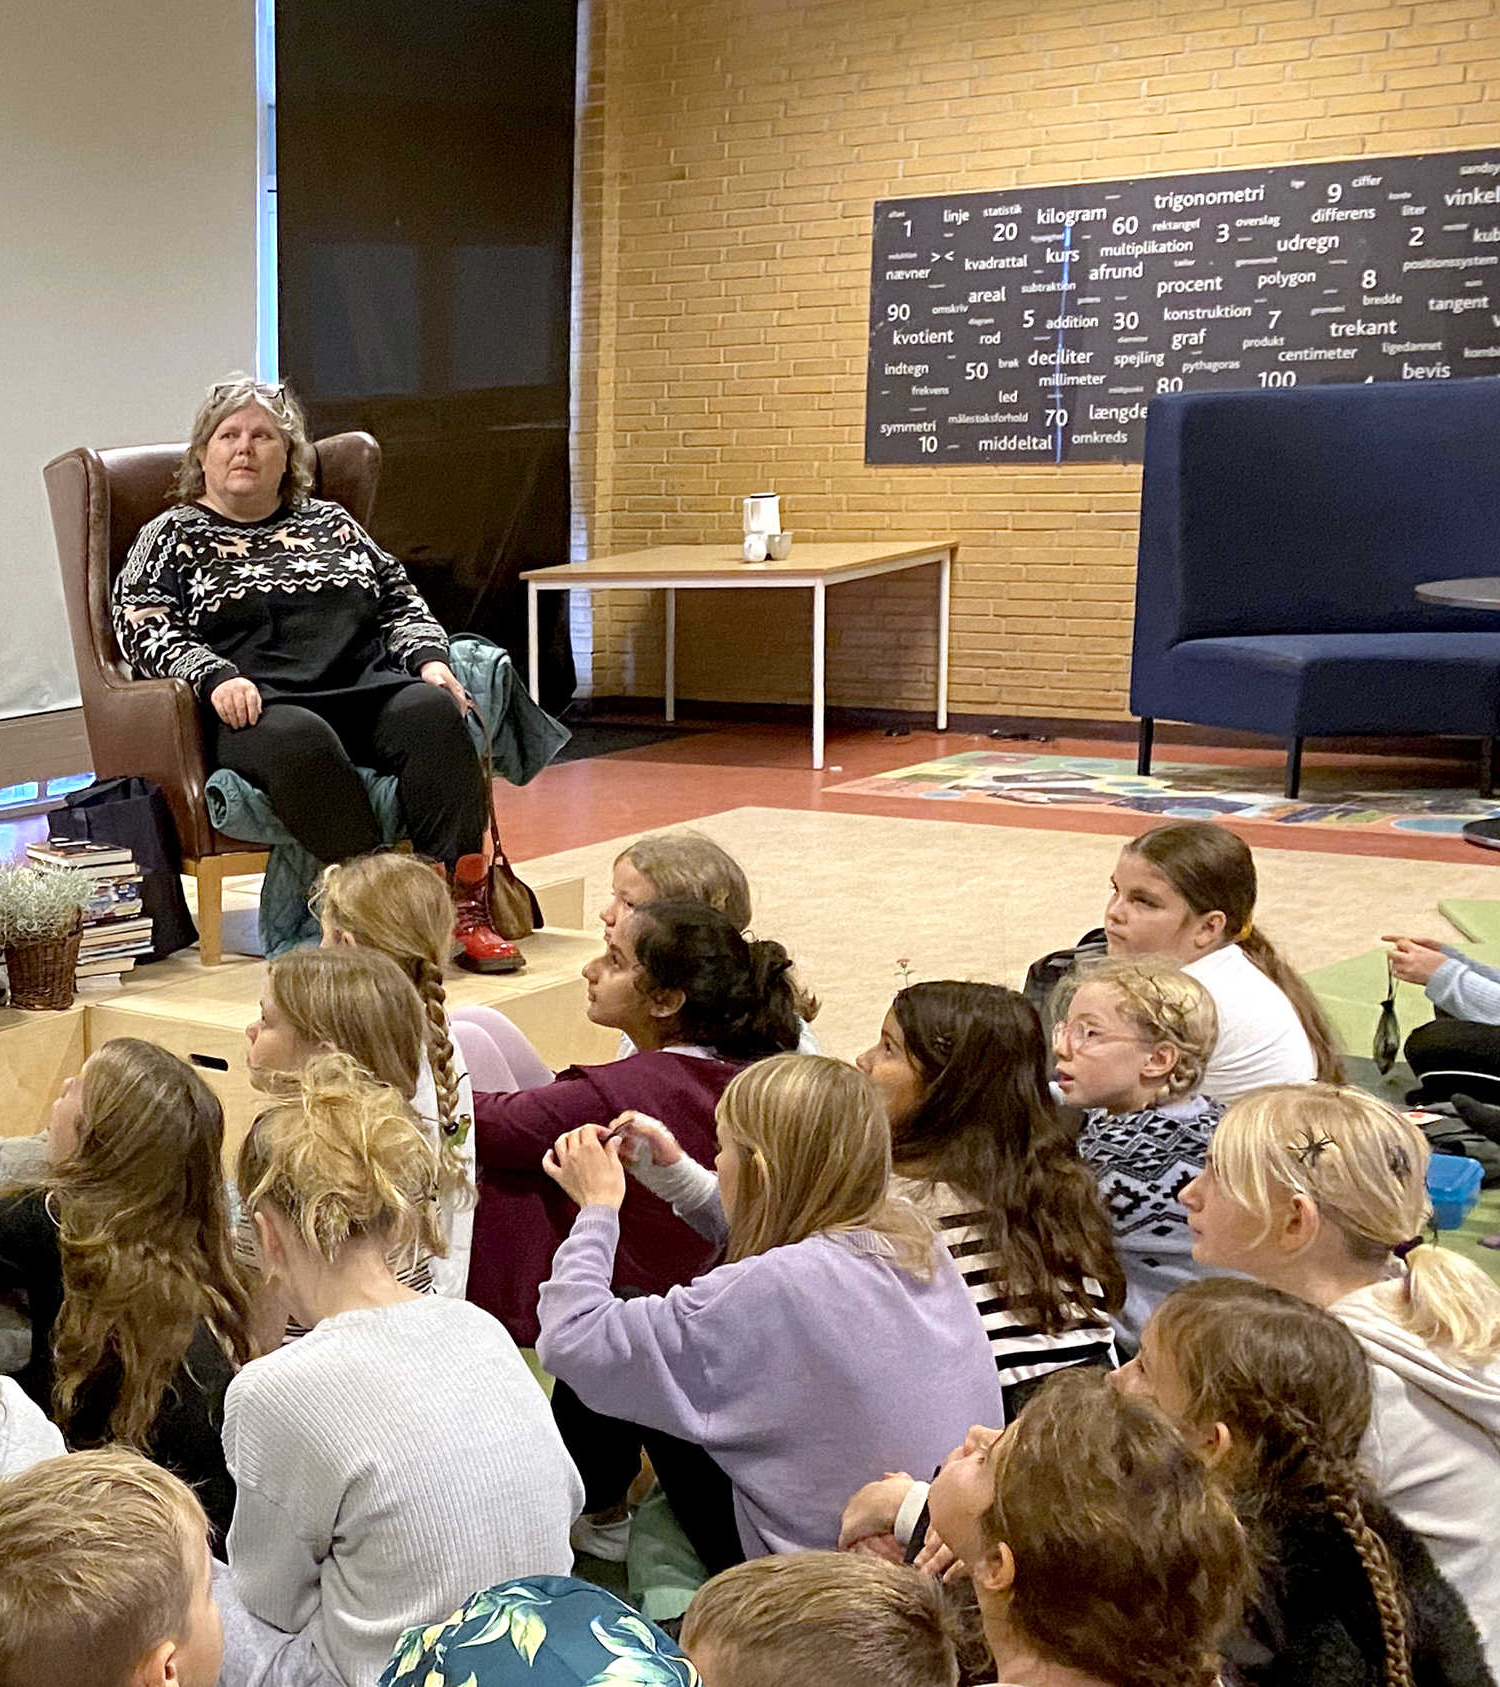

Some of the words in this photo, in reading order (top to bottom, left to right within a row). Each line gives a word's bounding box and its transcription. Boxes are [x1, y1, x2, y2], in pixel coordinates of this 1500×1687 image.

[1154, 184, 1265, 212] trigonometri
[1327, 183, 1342, 204] 9
[1444, 184, 1500, 207] vinkel
[943, 208, 971, 226] linje
[982, 203, 1023, 217] statistik
[1036, 206, 1108, 227] kilogram
[1311, 205, 1376, 224] differens
[902, 219, 913, 238] 1
[1112, 215, 1139, 236] 60
[1152, 217, 1201, 233] rektangel
[1235, 214, 1281, 228] overslag
[992, 222, 1018, 242] 20
[1215, 223, 1230, 243] 3
[1408, 226, 1425, 247] 2
[1100, 238, 1194, 258] multiplikation
[1276, 233, 1340, 255] udregn
[964, 253, 1028, 271] kvadrattal
[1046, 247, 1080, 264] kurs
[885, 268, 932, 281] nævner
[1088, 261, 1144, 281] afrund
[1257, 270, 1317, 289] polygon
[1361, 268, 1377, 290] 8
[967, 286, 1007, 303] areal
[1156, 276, 1224, 298] procent
[1362, 292, 1403, 306] bredde
[1427, 295, 1490, 314] tangent
[887, 303, 911, 322] 90
[931, 303, 969, 315] omskriv
[1163, 303, 1253, 321] konstruktion
[1022, 309, 1036, 329] 5
[1045, 314, 1100, 330] addition
[1112, 311, 1140, 331] 30
[1268, 309, 1283, 330] 7
[1329, 318, 1398, 338] trekant
[892, 327, 955, 346] kvotient
[978, 330, 1002, 345] rod
[1171, 328, 1208, 350] graf
[1242, 335, 1286, 351] produkt
[1027, 349, 1095, 367] deciliter
[1113, 350, 1166, 368] spejling
[1277, 346, 1358, 363] centimeter
[884, 361, 930, 378] indtegn
[964, 361, 989, 381] 50
[1181, 359, 1241, 373] pythagoras
[1402, 361, 1452, 380] bevis
[1038, 372, 1107, 387] millimeter
[1155, 376, 1184, 394] 80
[1257, 370, 1297, 389] 100
[911, 384, 950, 396] frekvens
[998, 389, 1019, 404] led
[1044, 408, 1069, 428] 70
[1088, 403, 1148, 424] længde
[879, 419, 937, 437] symmetri
[1071, 429, 1128, 445] omkreds
[918, 435, 939, 454] 10
[978, 433, 1053, 452] middeltal
